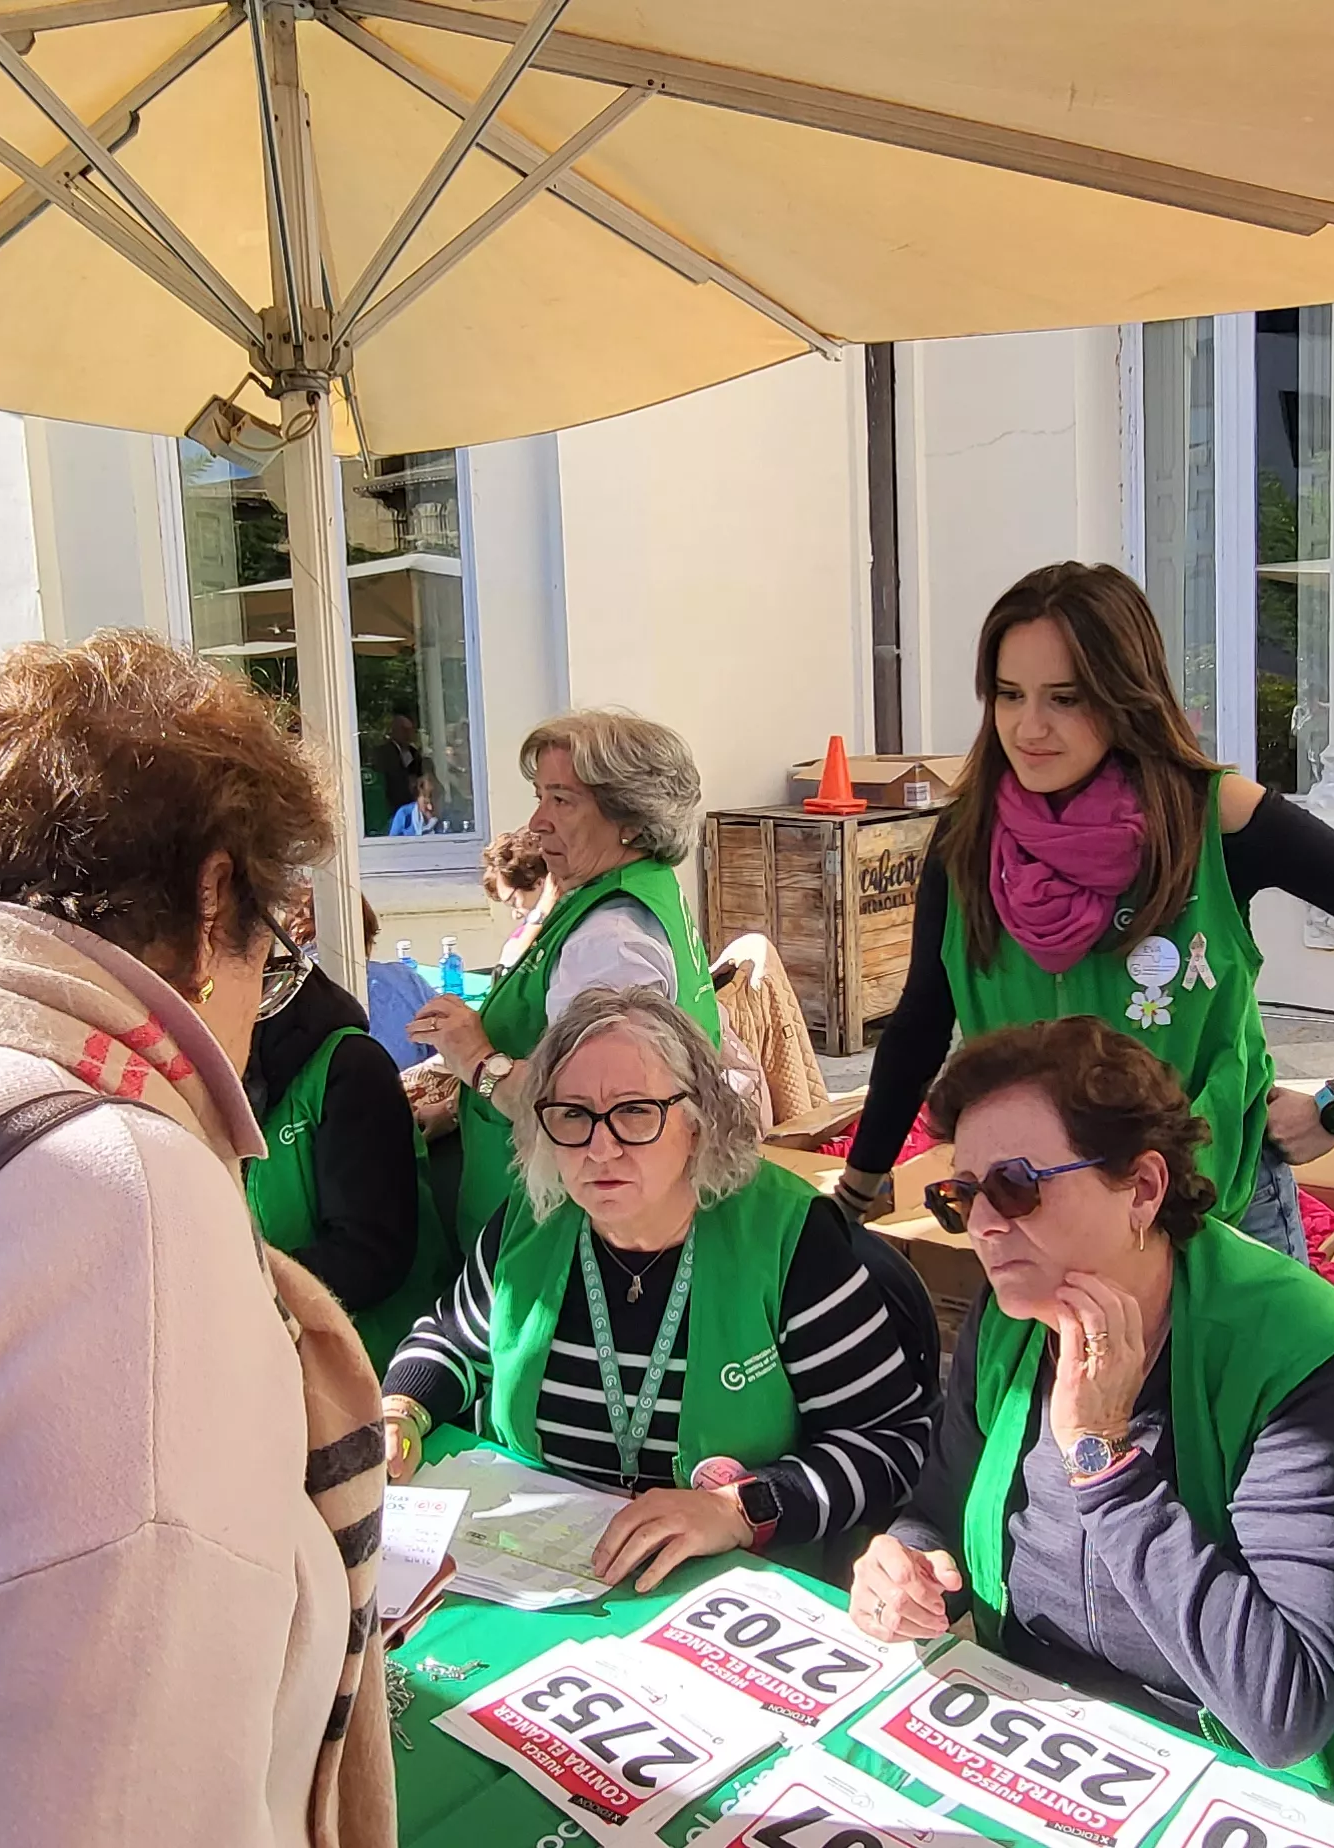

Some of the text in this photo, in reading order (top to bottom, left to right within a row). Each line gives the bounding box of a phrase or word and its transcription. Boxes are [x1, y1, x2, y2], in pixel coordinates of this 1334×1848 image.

[663, 1627, 817, 1711] CONTRA EL CÁNCER
[686, 1597, 871, 1696] 2703
[700, 1658, 750, 1690] HUESCA
[493, 1703, 629, 1806] CONTRA EL CÁNCER
[521, 1676, 700, 1788] 2753
[521, 1741, 565, 1777] HUESCA
[906, 1717, 1108, 1829] CONTRA EL CÁNCER
[929, 1682, 1157, 1807] 2550
[961, 1767, 1024, 1804] HUESCA
